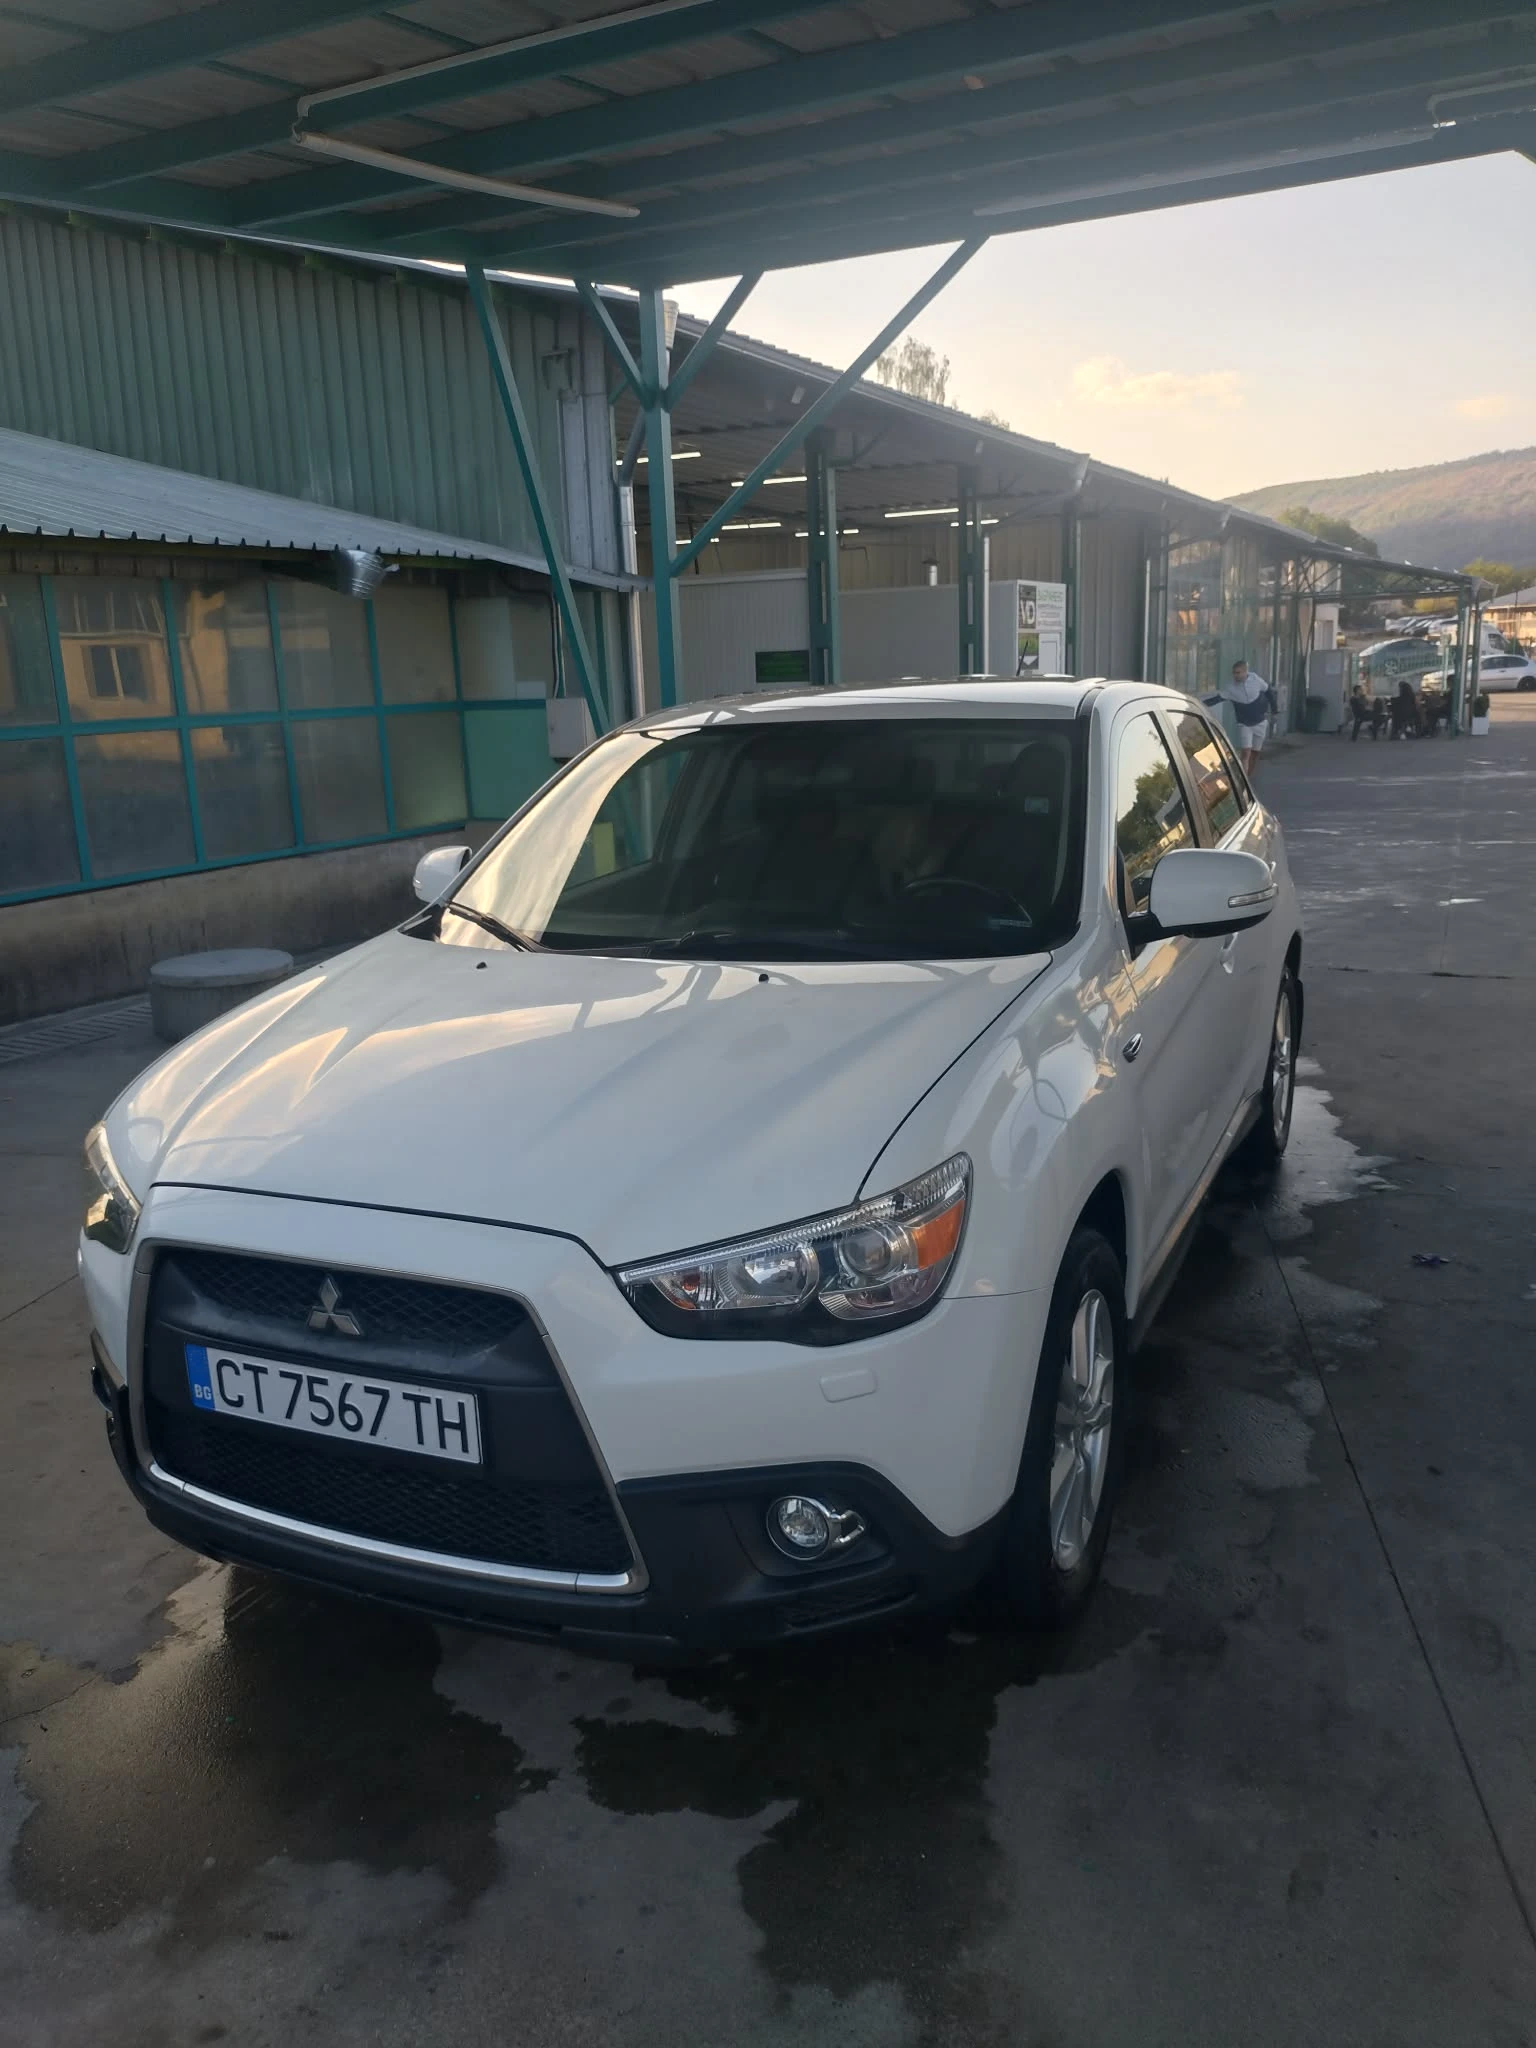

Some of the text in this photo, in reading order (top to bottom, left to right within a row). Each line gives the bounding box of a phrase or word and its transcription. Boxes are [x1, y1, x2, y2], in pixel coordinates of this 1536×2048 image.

[194, 1383, 212, 1400] BG
[215, 1358, 469, 1453] CT 7567 TH
